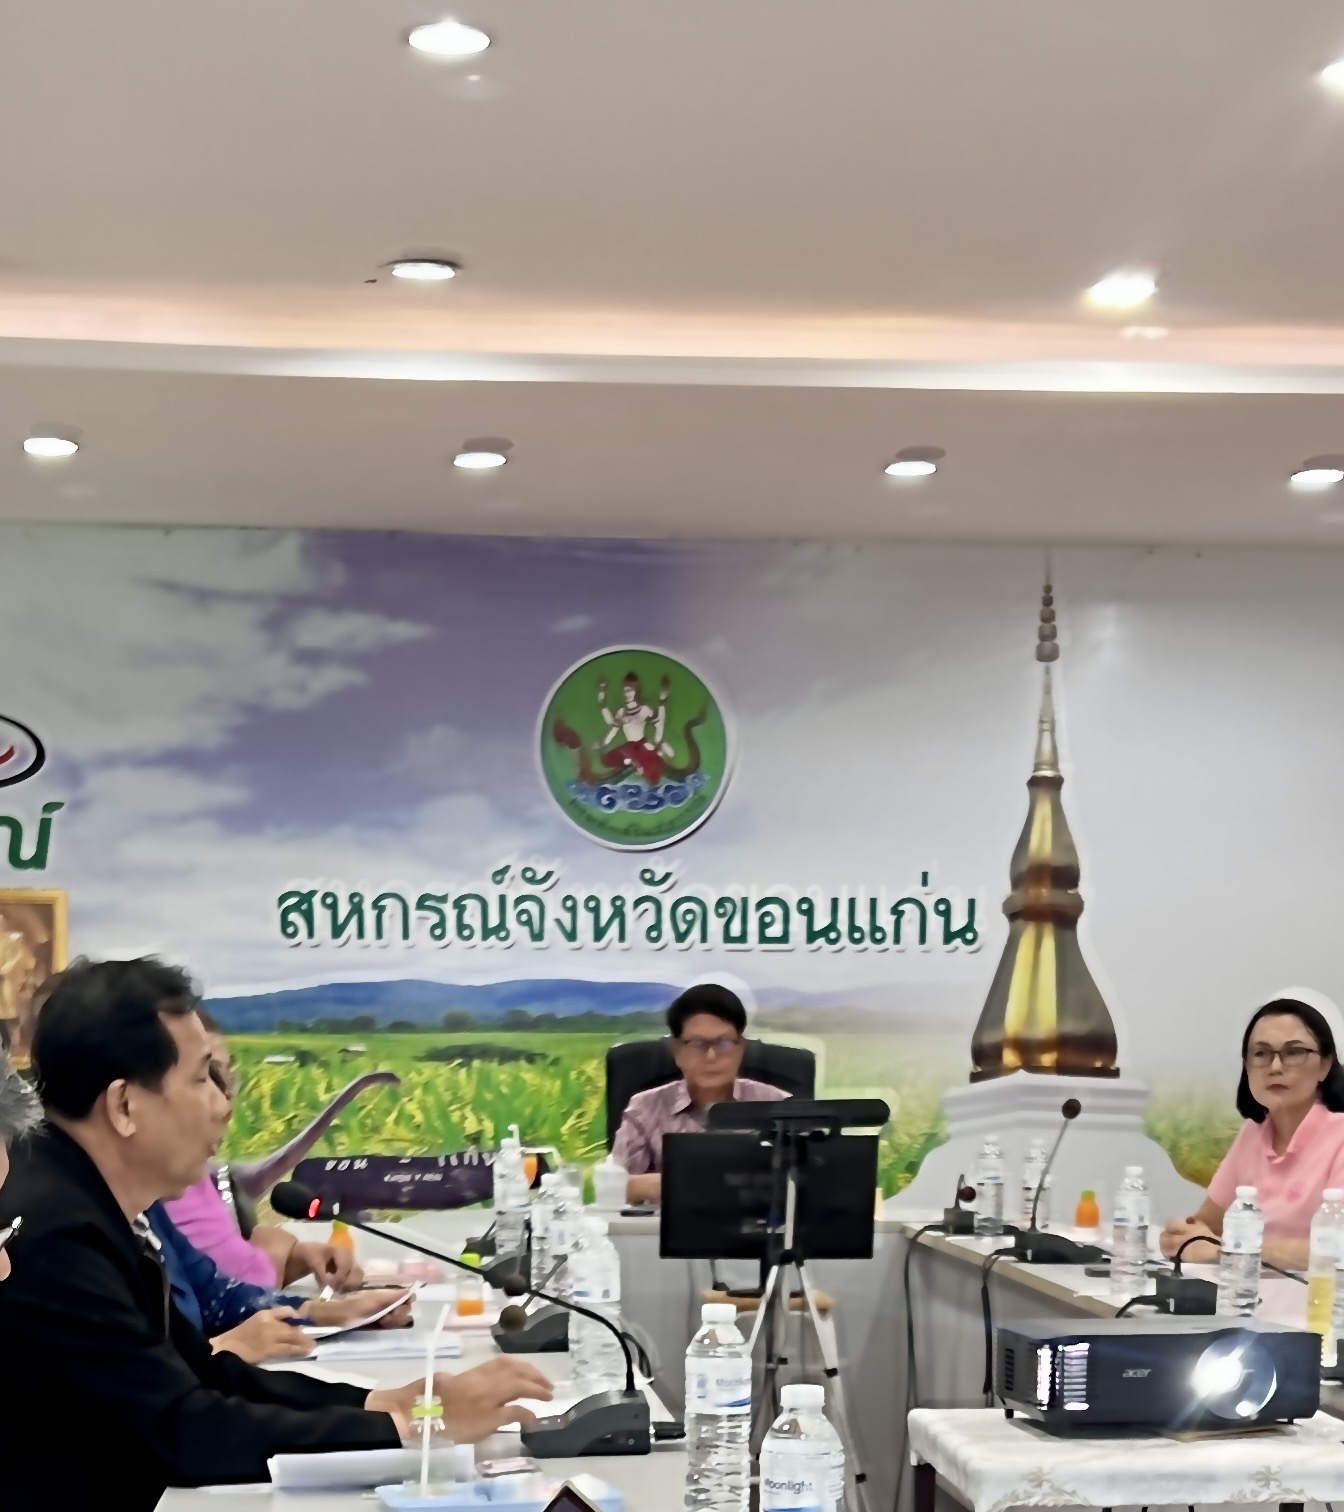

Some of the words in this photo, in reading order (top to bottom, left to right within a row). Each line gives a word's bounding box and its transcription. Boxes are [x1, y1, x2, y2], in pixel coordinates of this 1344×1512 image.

[277, 864, 980, 949] สหกรณ์จังหวัดขอนแก่น
[1122, 1368, 1152, 1378] acer
